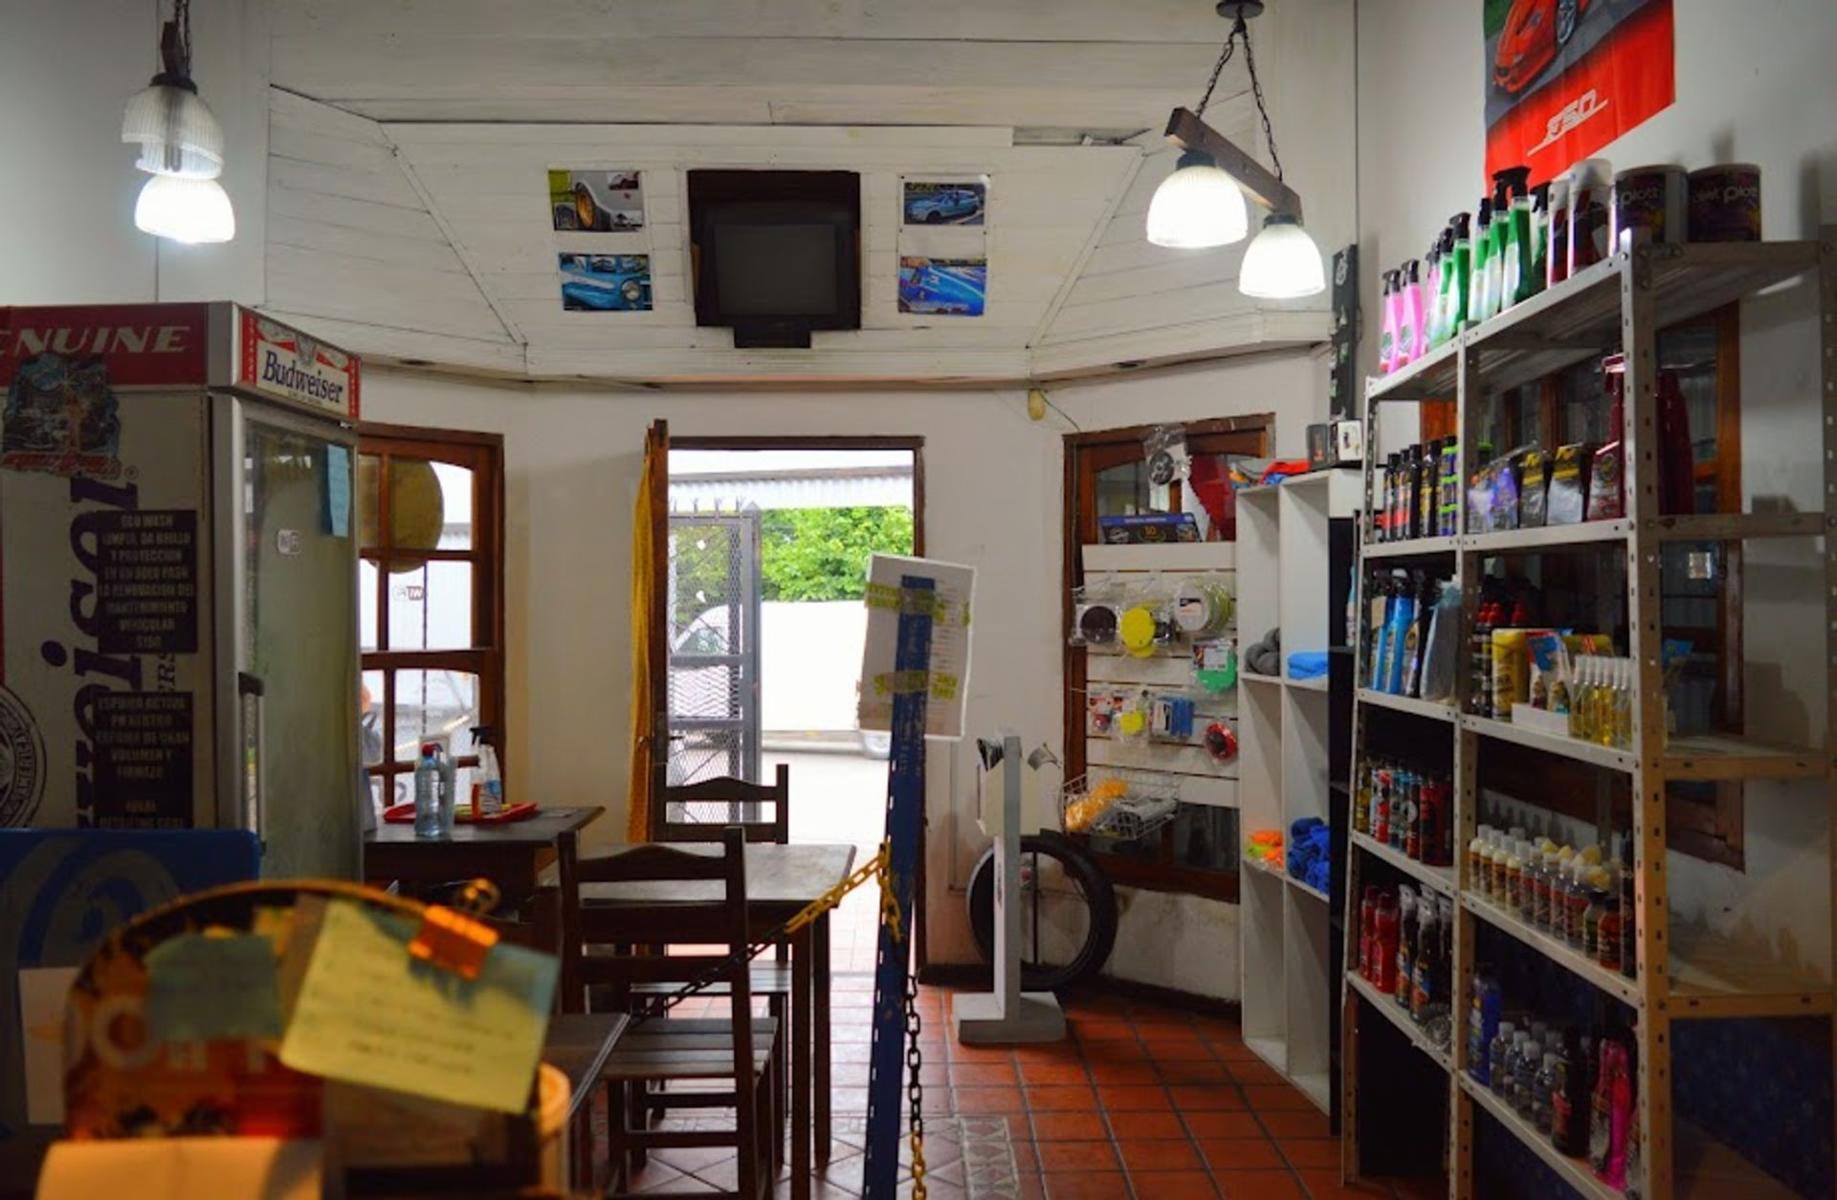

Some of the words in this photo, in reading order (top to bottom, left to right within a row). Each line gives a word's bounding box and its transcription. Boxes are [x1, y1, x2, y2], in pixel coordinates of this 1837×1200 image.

[0, 325, 190, 354] NUINE
[262, 350, 344, 404] Budweiser
[142, 514, 174, 528] WASH
